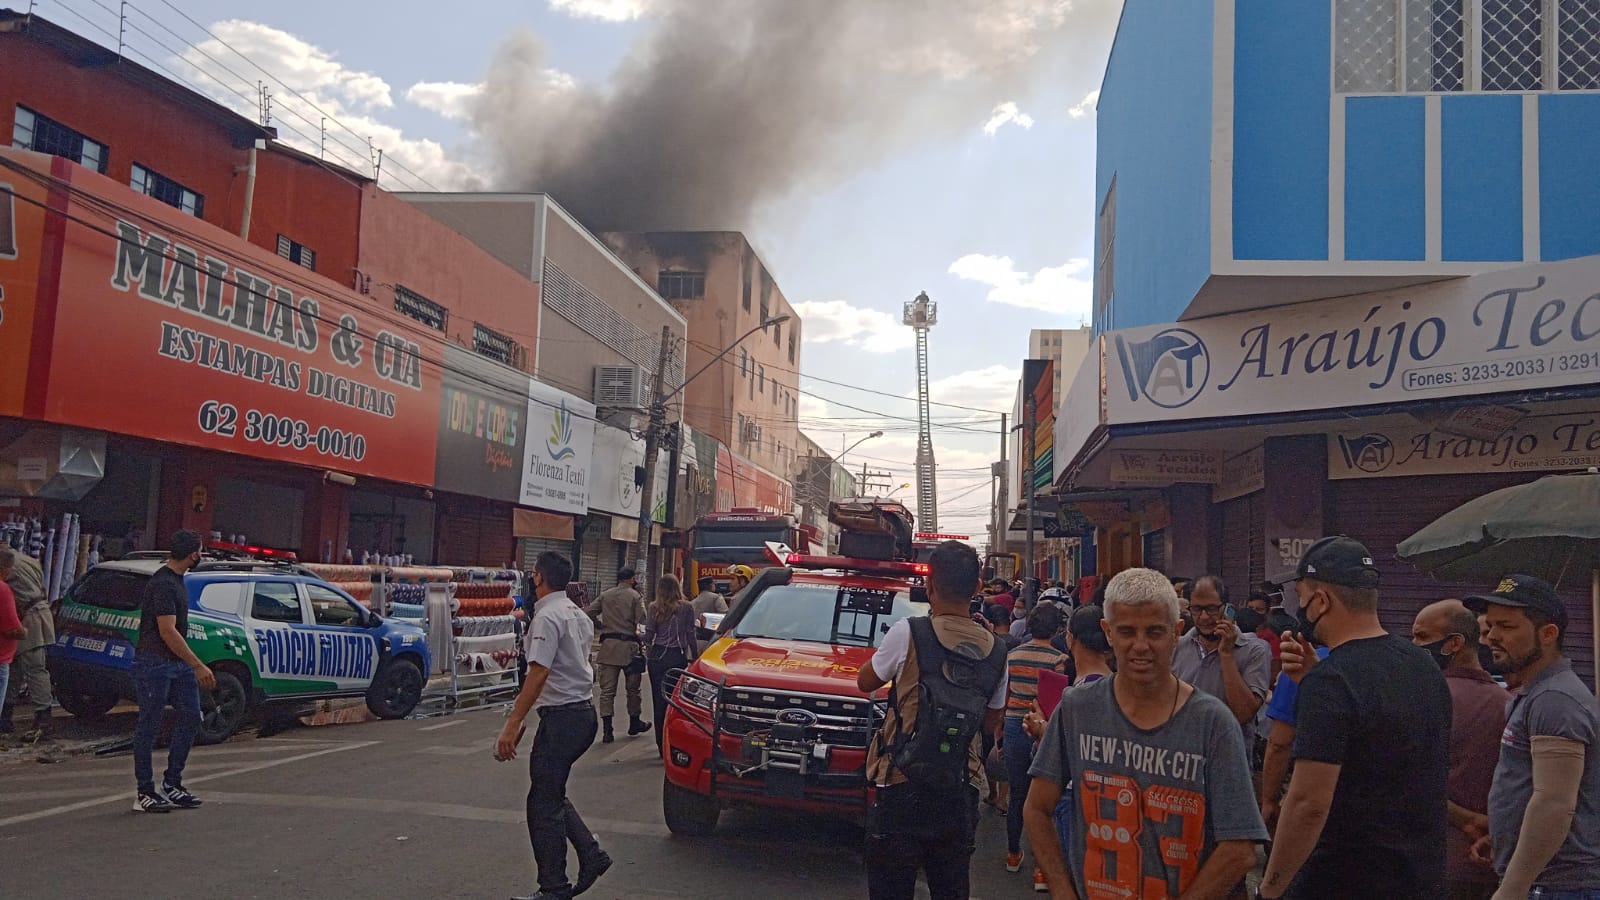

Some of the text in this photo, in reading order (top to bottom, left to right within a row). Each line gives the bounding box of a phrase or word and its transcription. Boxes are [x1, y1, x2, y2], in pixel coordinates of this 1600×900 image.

[111, 219, 422, 390] MALHAS & CIA
[159, 321, 396, 418] ESTAMPAS DIGITAIS
[1217, 301, 1447, 391] Araújo
[1409, 370, 1458, 388] Fones:
[1462, 357, 1545, 383] 3233-2033
[199, 400, 366, 463] 62 3093-0010
[530, 454, 585, 487] Florenza Textil
[96, 611, 141, 631] MILITAR
[254, 628, 374, 680] POLÍCIA MILITAR
[786, 711, 807, 722] Ford
